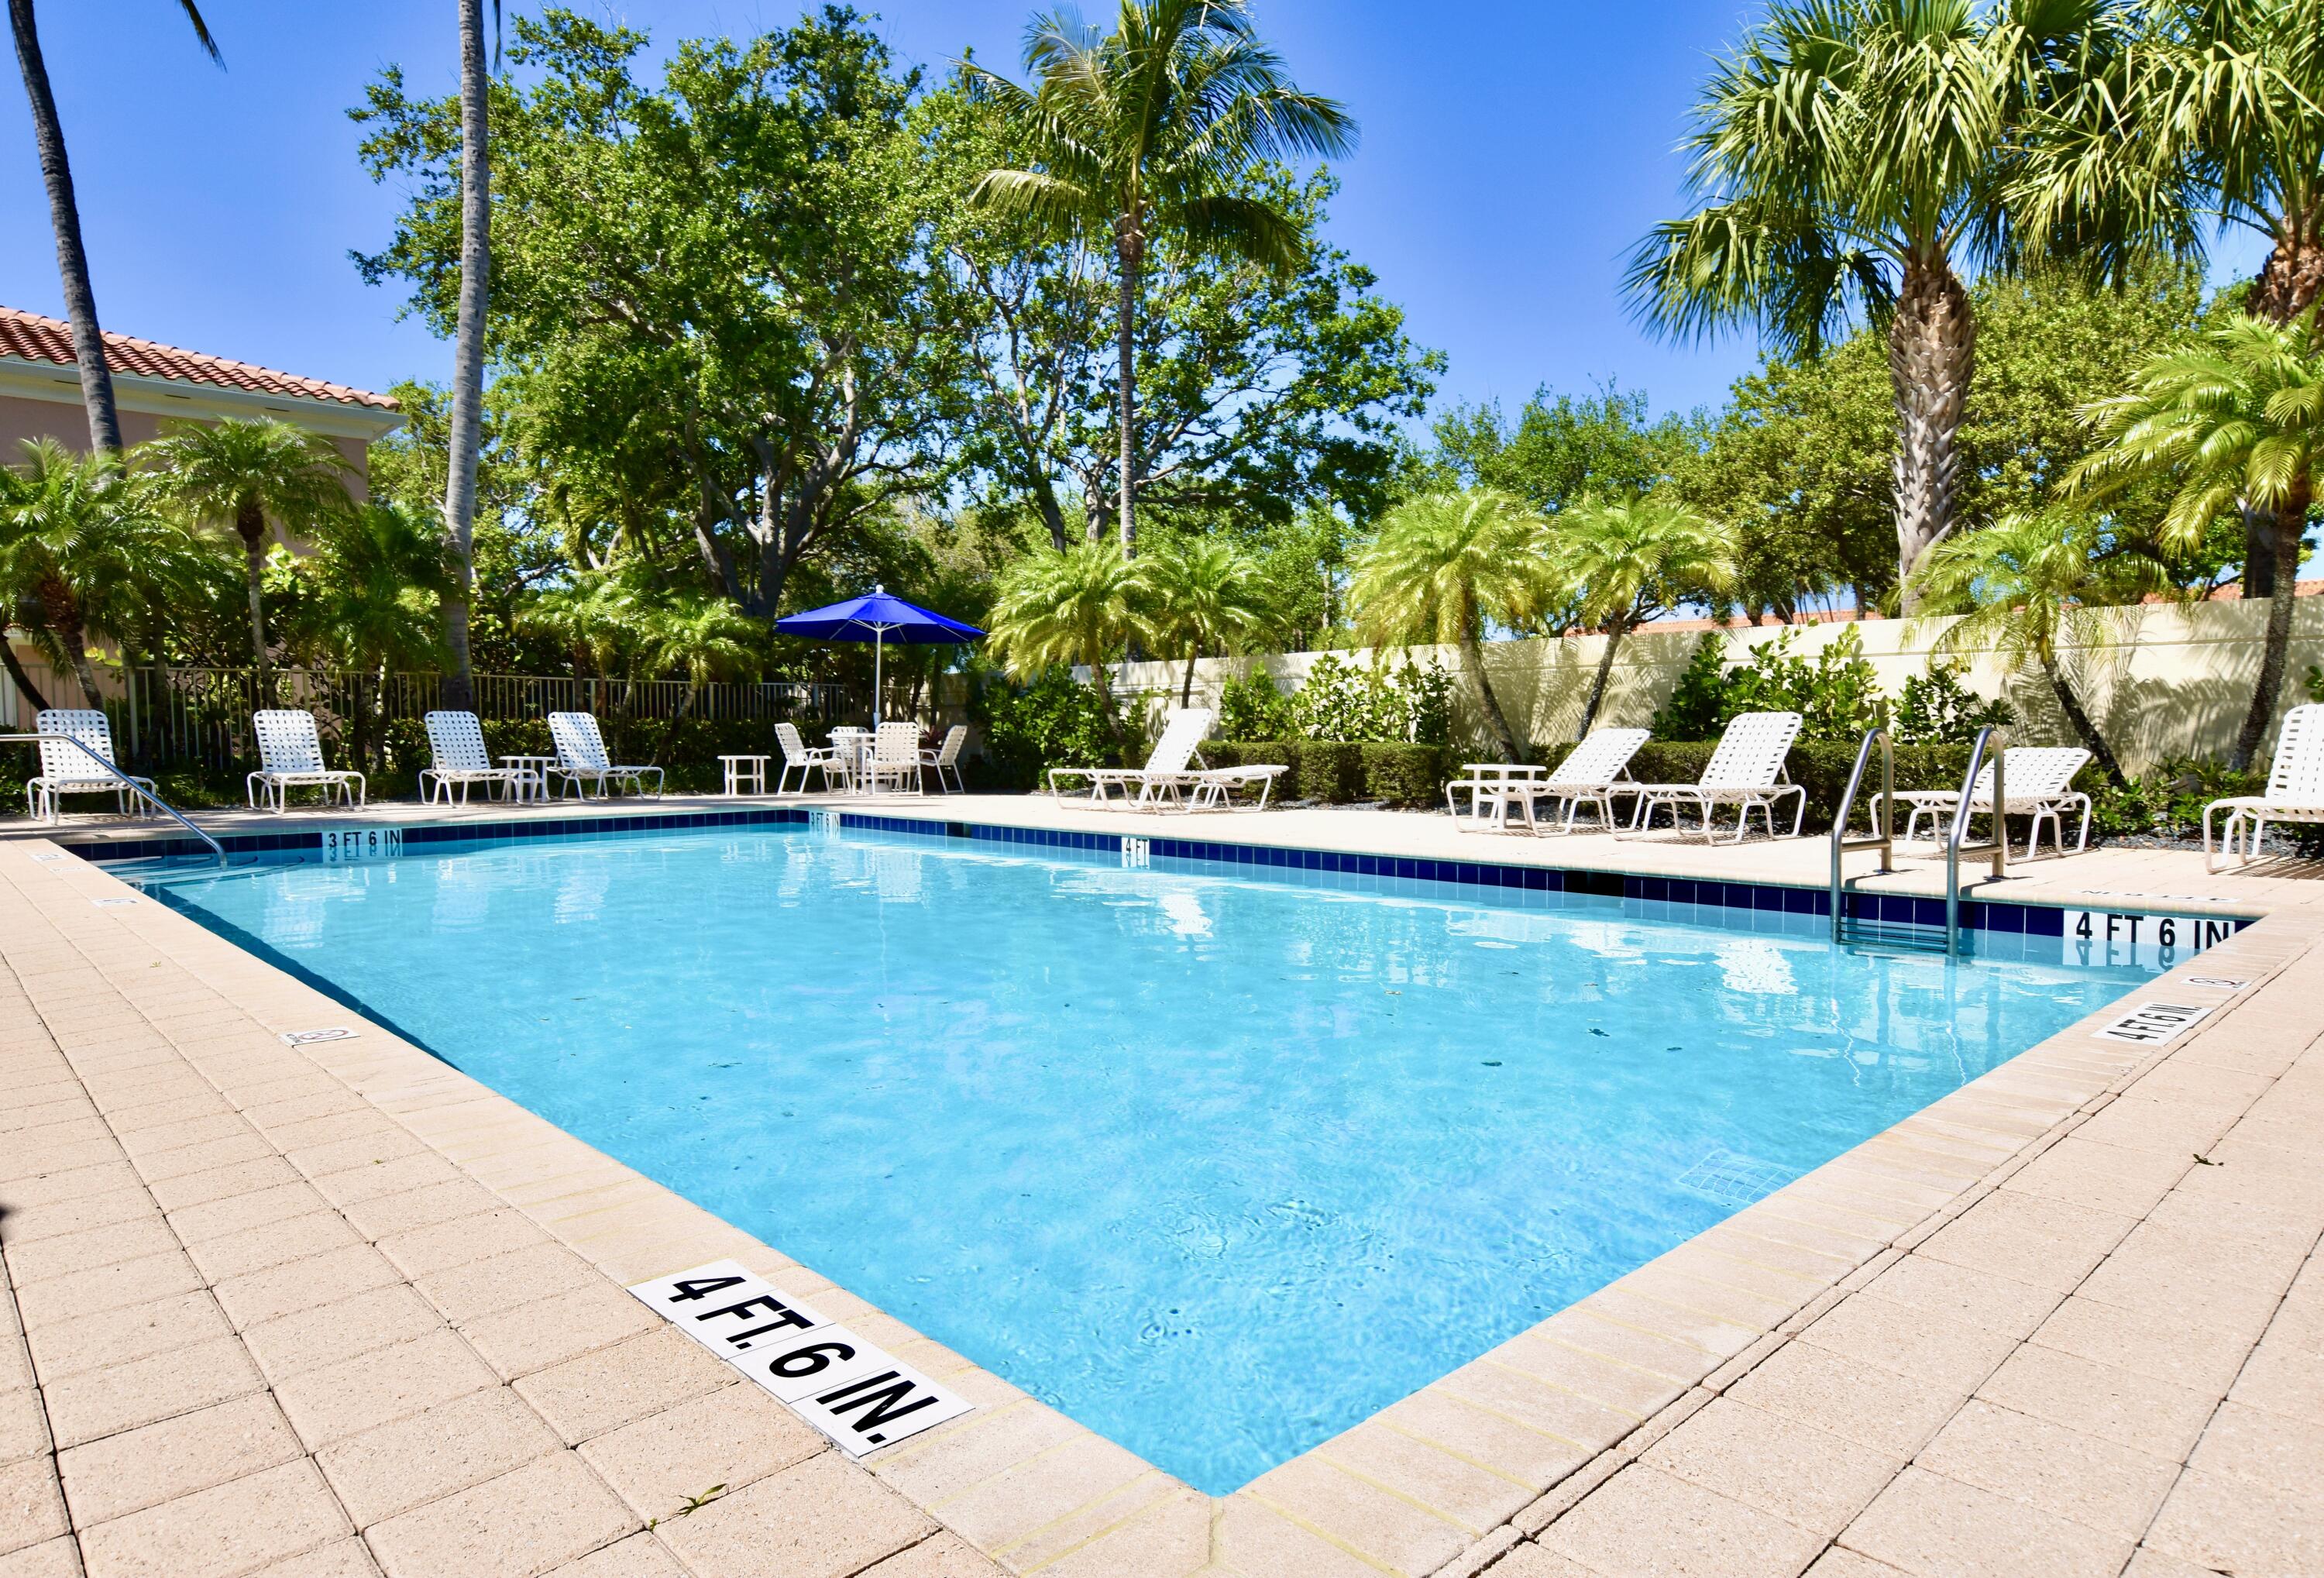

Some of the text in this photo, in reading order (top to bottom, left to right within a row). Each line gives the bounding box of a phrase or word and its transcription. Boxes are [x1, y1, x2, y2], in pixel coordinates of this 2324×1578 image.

[328, 830, 400, 847] 3 FT 6 IN
[1126, 837, 1148, 855] 4 FT
[2076, 912, 2229, 950] 4 FT 6 IN
[2107, 1031, 2159, 1040] 4
[2137, 1013, 2187, 1022] 6
[668, 1276, 940, 1445] 4 FT. 6 IN.
